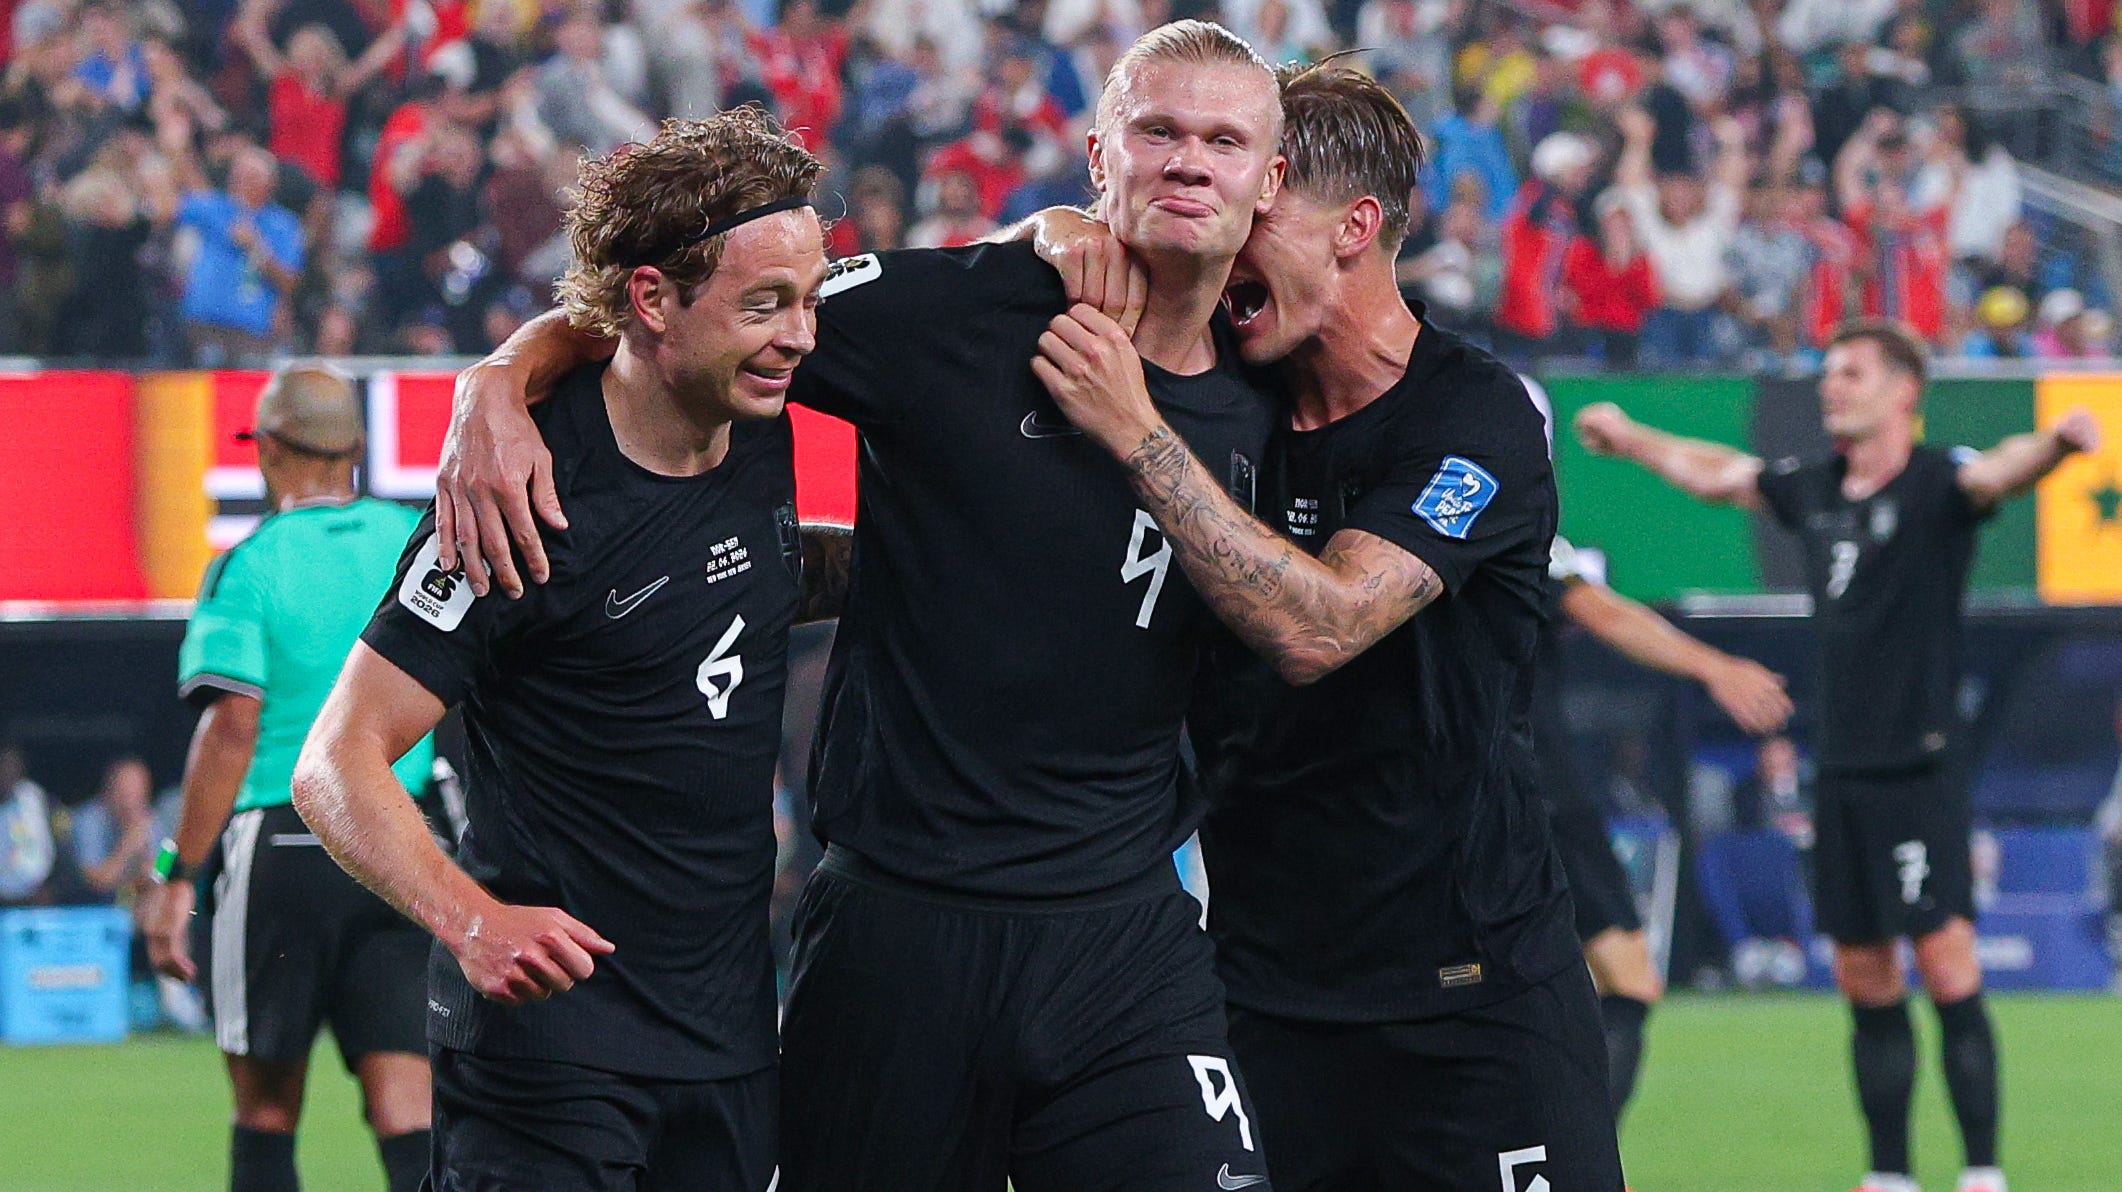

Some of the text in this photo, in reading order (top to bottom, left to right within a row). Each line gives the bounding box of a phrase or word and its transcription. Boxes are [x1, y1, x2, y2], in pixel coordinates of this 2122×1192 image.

[427, 583, 443, 597] FIFA
[1121, 508, 1172, 629] 9
[410, 596, 441, 618] 2026
[415, 589, 444, 611] WORLD CUP
[696, 614, 746, 720] 6
[1187, 1055, 1255, 1152] 9
